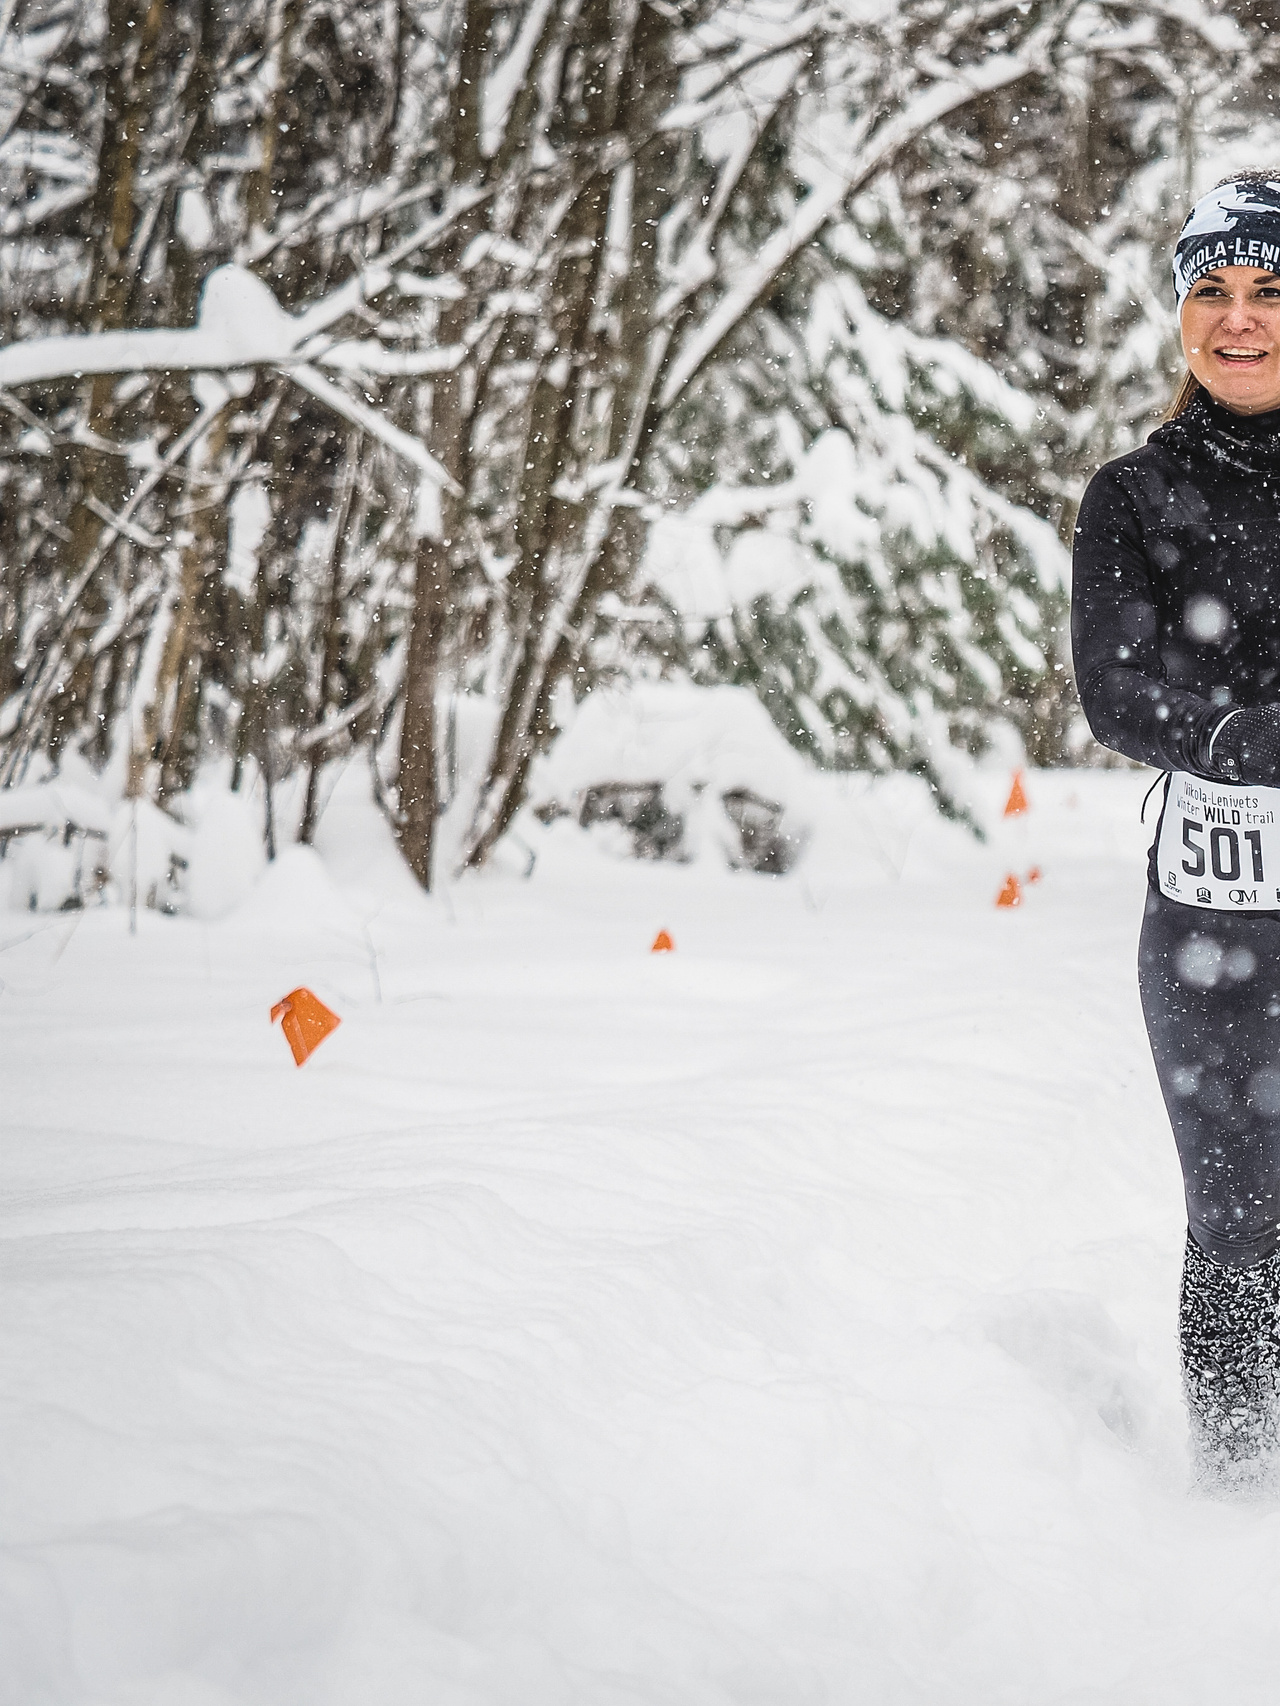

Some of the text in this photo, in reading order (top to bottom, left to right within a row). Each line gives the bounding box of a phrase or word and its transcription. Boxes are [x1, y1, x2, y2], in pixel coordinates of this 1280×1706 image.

[1177, 793, 1275, 825] Winter WILD trail
[1184, 781, 1259, 809] Nikola-Lenivets
[1181, 816, 1264, 882] 501
